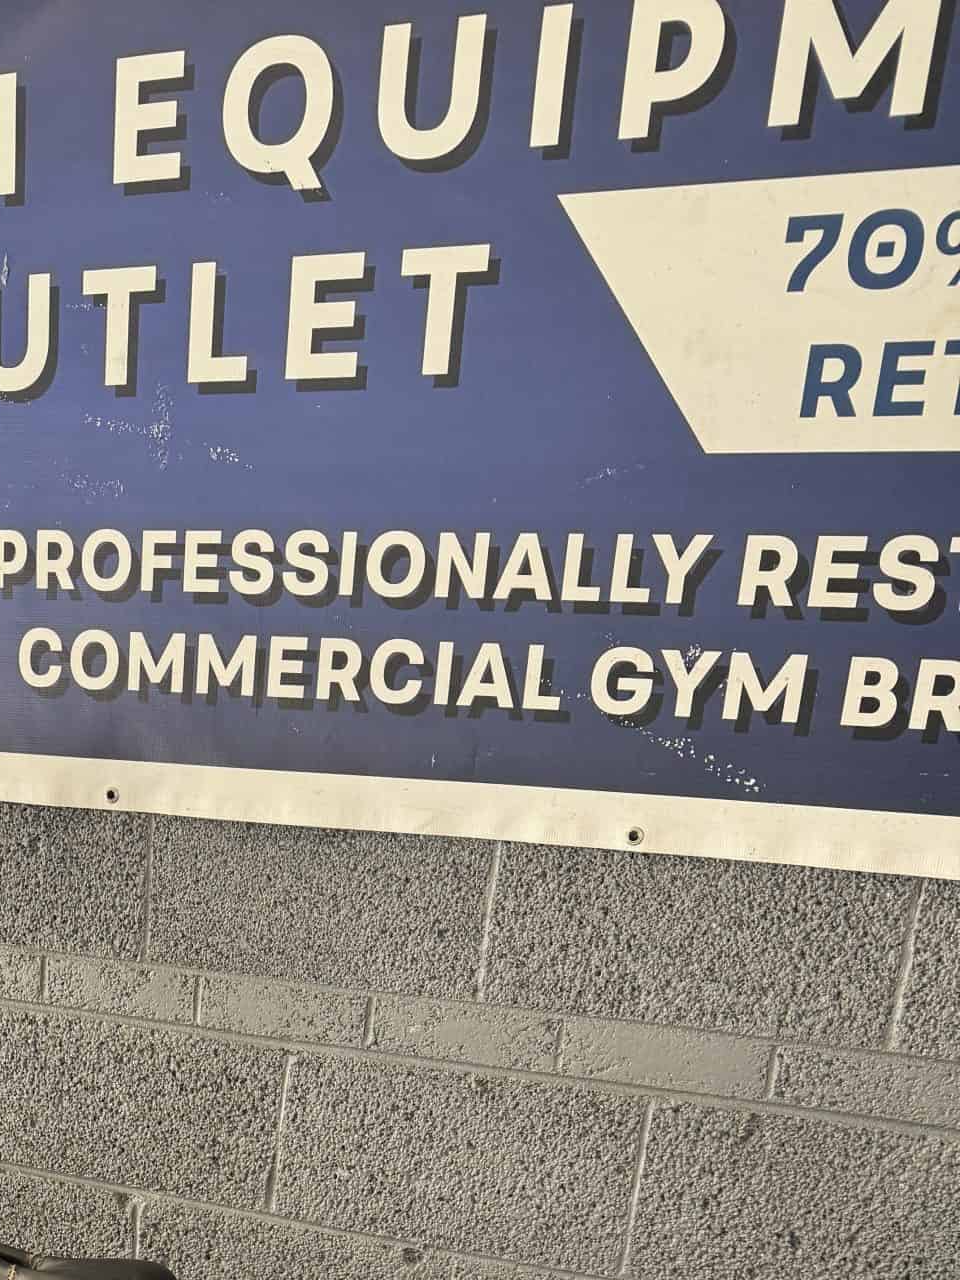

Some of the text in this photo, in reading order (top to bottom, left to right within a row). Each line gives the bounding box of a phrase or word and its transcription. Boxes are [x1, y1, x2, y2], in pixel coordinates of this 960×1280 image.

[113, 0, 942, 192] EQUIPM
[737, 534, 960, 612] RES
[18, 627, 562, 711] COMMERCIAL
[590, 646, 808, 724] GYM
